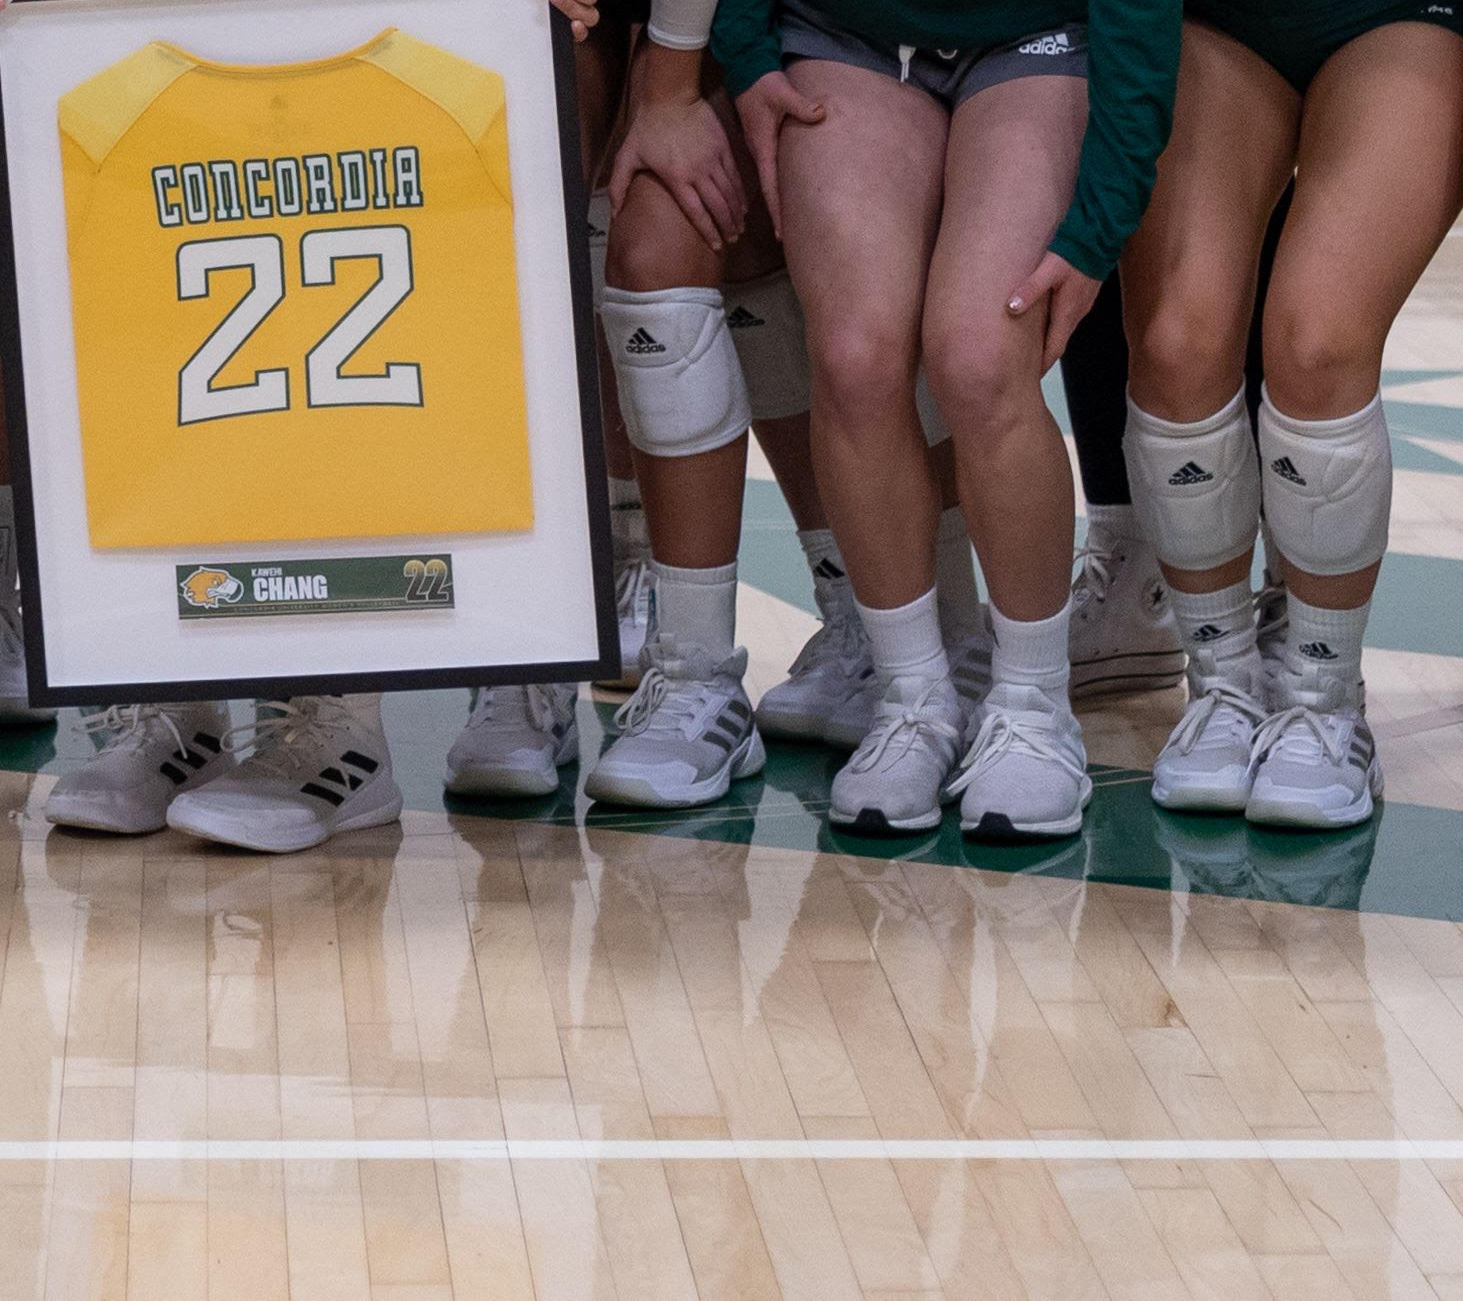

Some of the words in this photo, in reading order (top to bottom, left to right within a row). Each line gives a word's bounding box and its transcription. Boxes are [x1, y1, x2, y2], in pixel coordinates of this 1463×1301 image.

[152, 146, 424, 228] CONCORDIA
[176, 224, 425, 427] 22
[625, 344, 666, 354] adidas
[1169, 473, 1213, 485] adidas
[251, 567, 283, 578] KAWEHI
[403, 558, 449, 602] 22
[253, 574, 328, 602] CHANG
